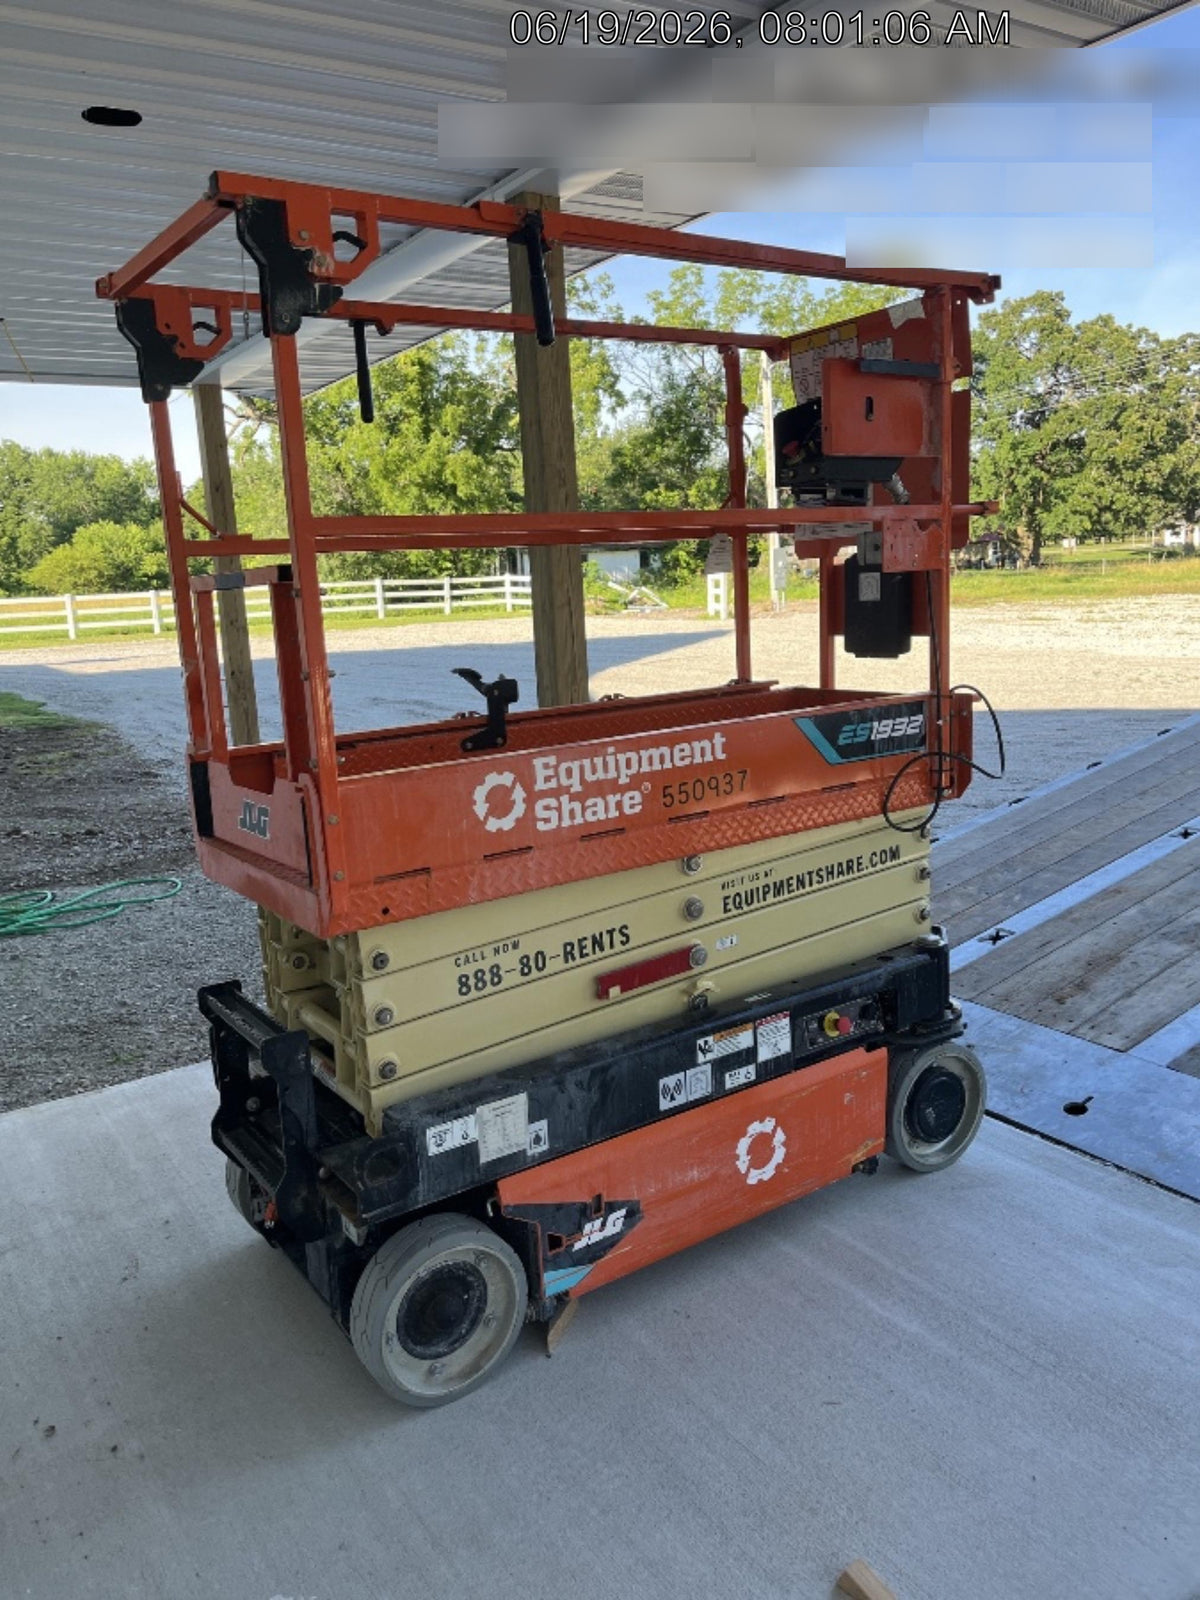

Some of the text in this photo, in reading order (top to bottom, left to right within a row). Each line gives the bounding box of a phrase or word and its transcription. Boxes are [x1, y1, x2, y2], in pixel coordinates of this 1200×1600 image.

[532, 732, 726, 793] Equipment
[662, 769, 748, 808] 550937
[238, 799, 270, 839] JLG
[722, 844, 901, 914] EQUIPMENTSHARE.COM
[454, 938, 521, 968] CALL NOW
[457, 924, 631, 997] 888-80-RENTS
[572, 1207, 628, 1252] JLG
